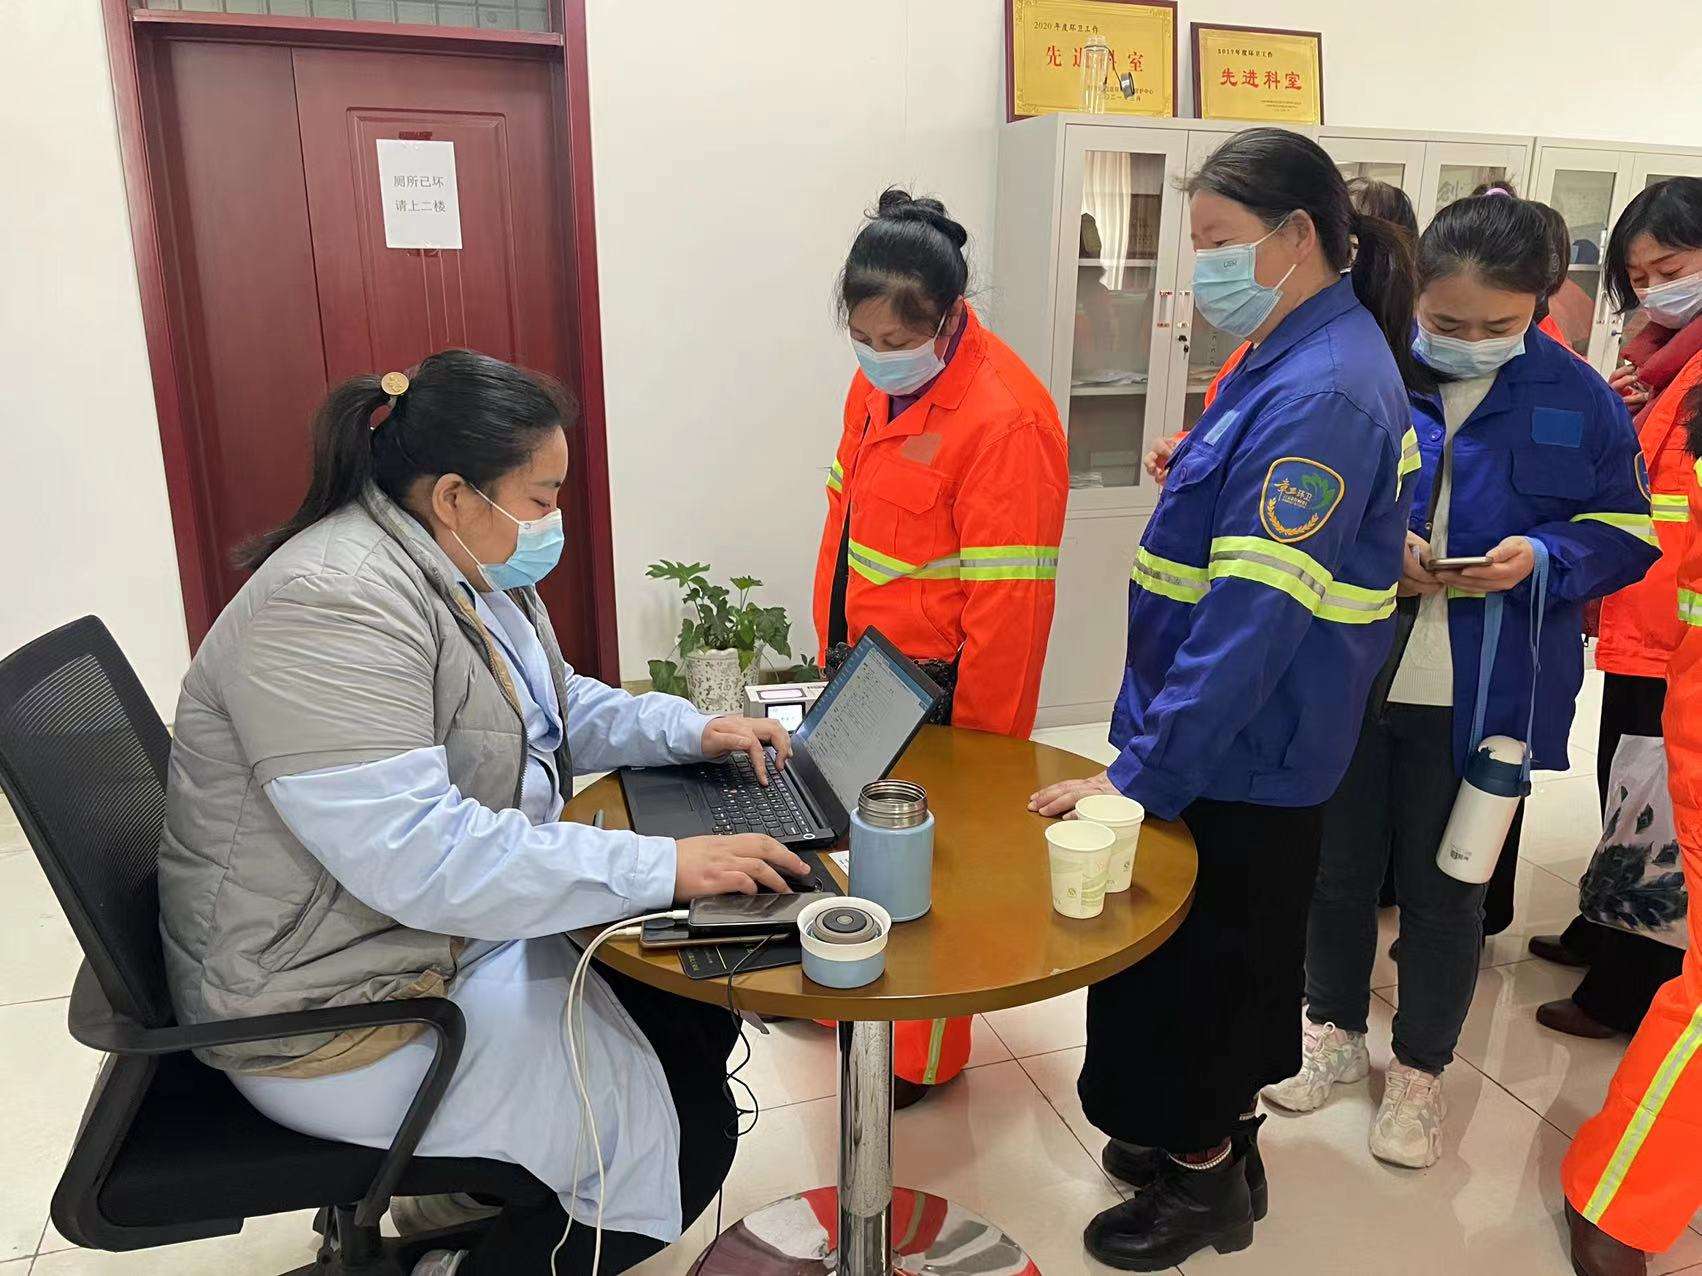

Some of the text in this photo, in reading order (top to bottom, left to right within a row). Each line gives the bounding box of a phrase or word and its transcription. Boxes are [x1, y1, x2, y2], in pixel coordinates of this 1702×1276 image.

[1220, 67, 1303, 91] 先进科室
[393, 175, 446, 189] 厕所已坏
[395, 199, 447, 214] 请上二楼
